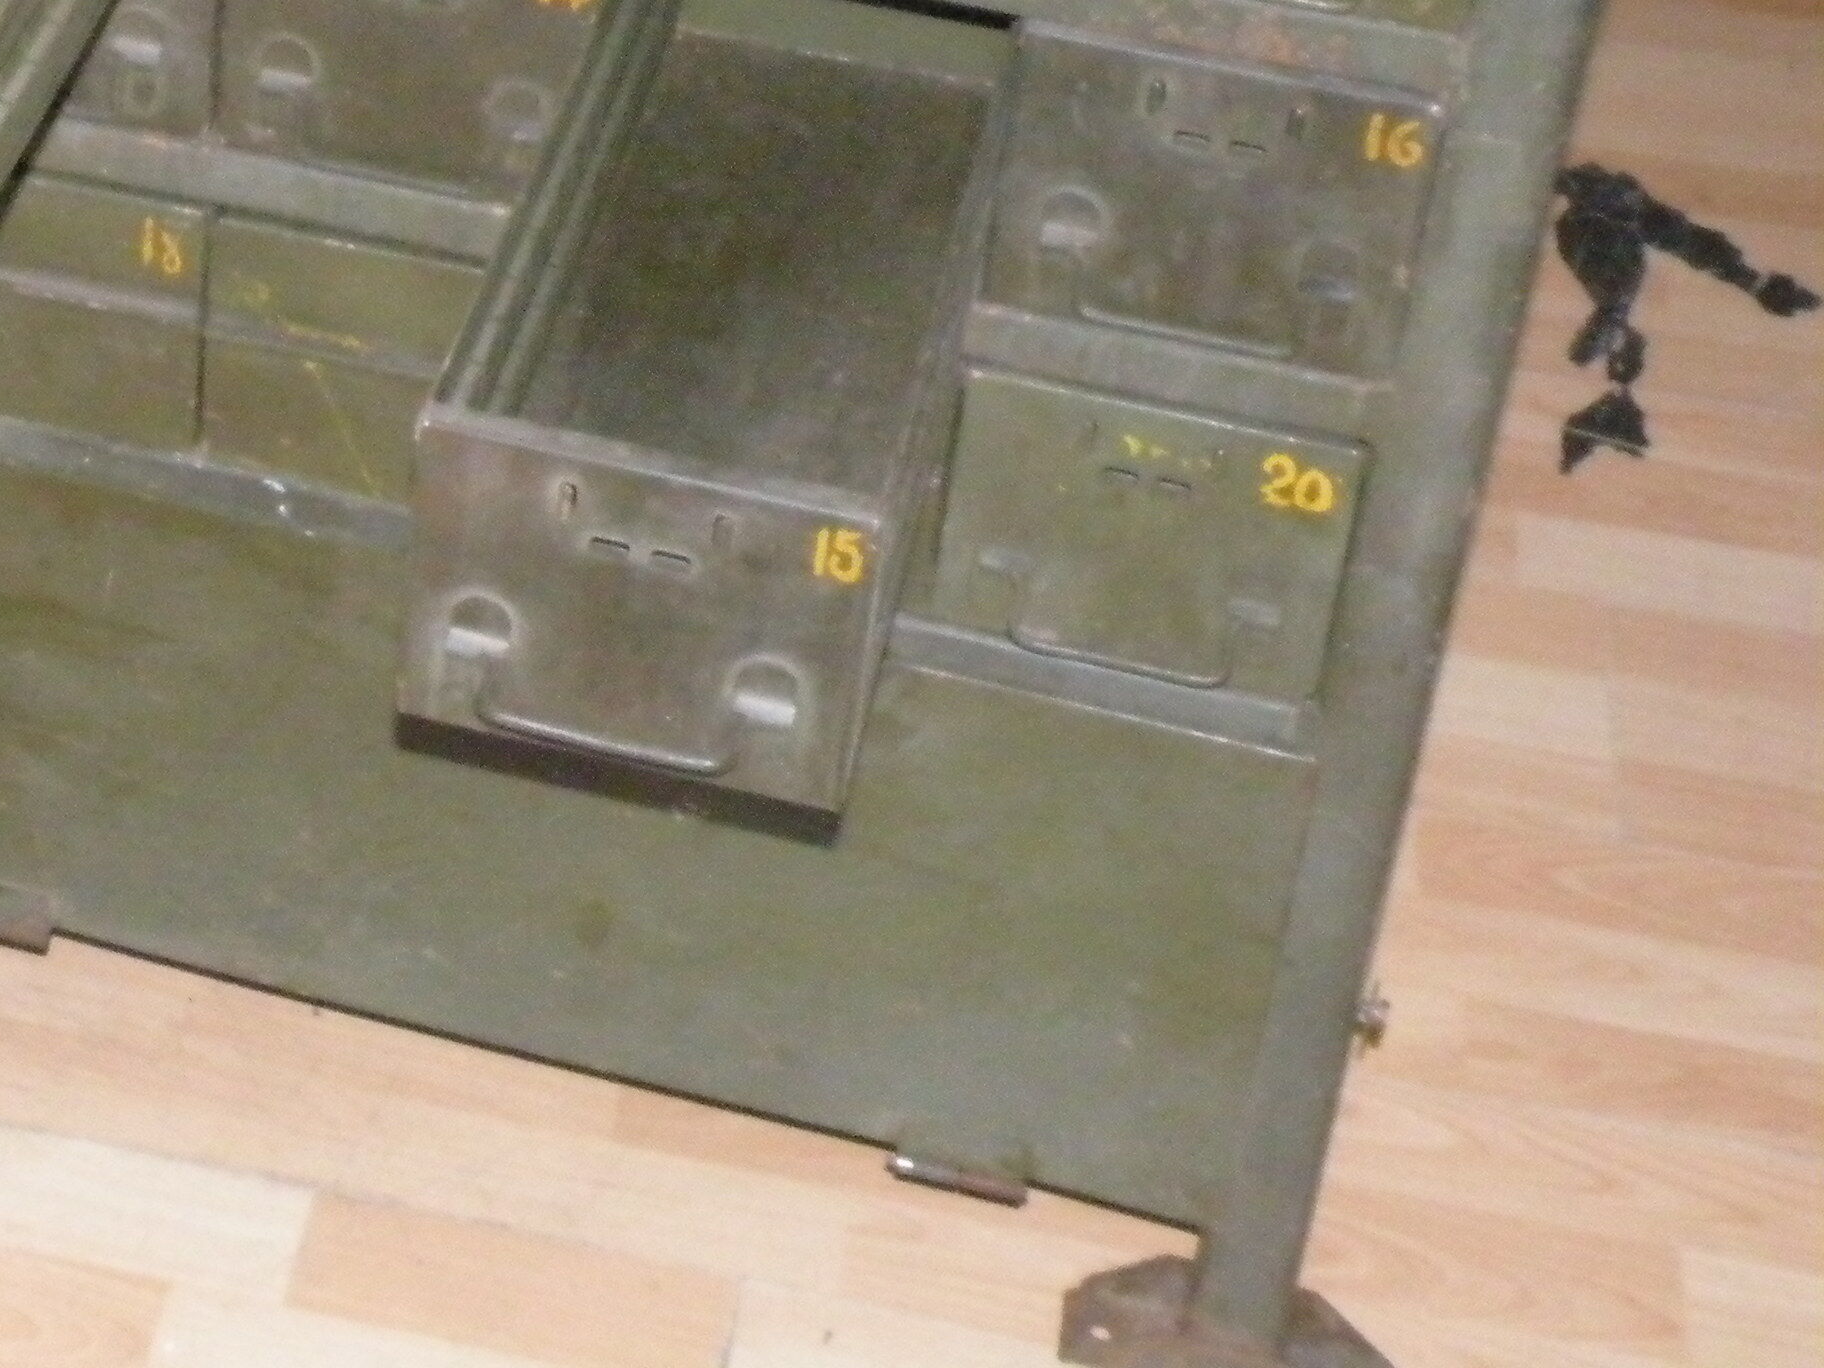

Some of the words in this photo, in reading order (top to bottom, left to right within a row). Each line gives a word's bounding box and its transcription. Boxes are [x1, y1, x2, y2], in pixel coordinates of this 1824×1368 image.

[1361, 112, 1426, 168] 16
[1259, 452, 1336, 516] 20
[812, 526, 865, 584] 15
